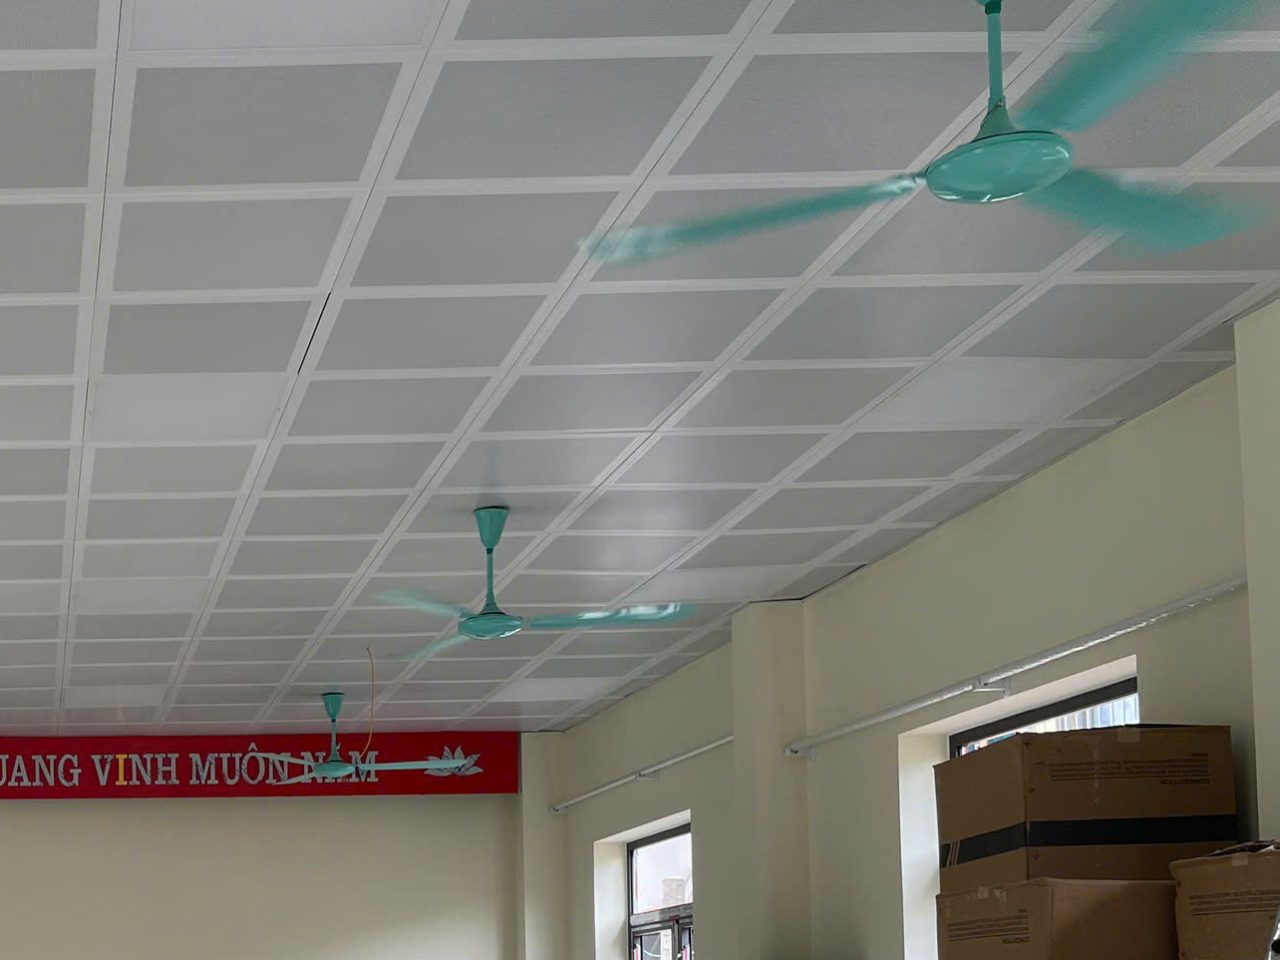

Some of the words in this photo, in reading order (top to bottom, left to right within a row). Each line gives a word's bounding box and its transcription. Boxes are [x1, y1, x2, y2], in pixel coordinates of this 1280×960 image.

[91, 753, 179, 787] VINH
[189, 742, 291, 785] MUÔN
[300, 751, 379, 783] NM
